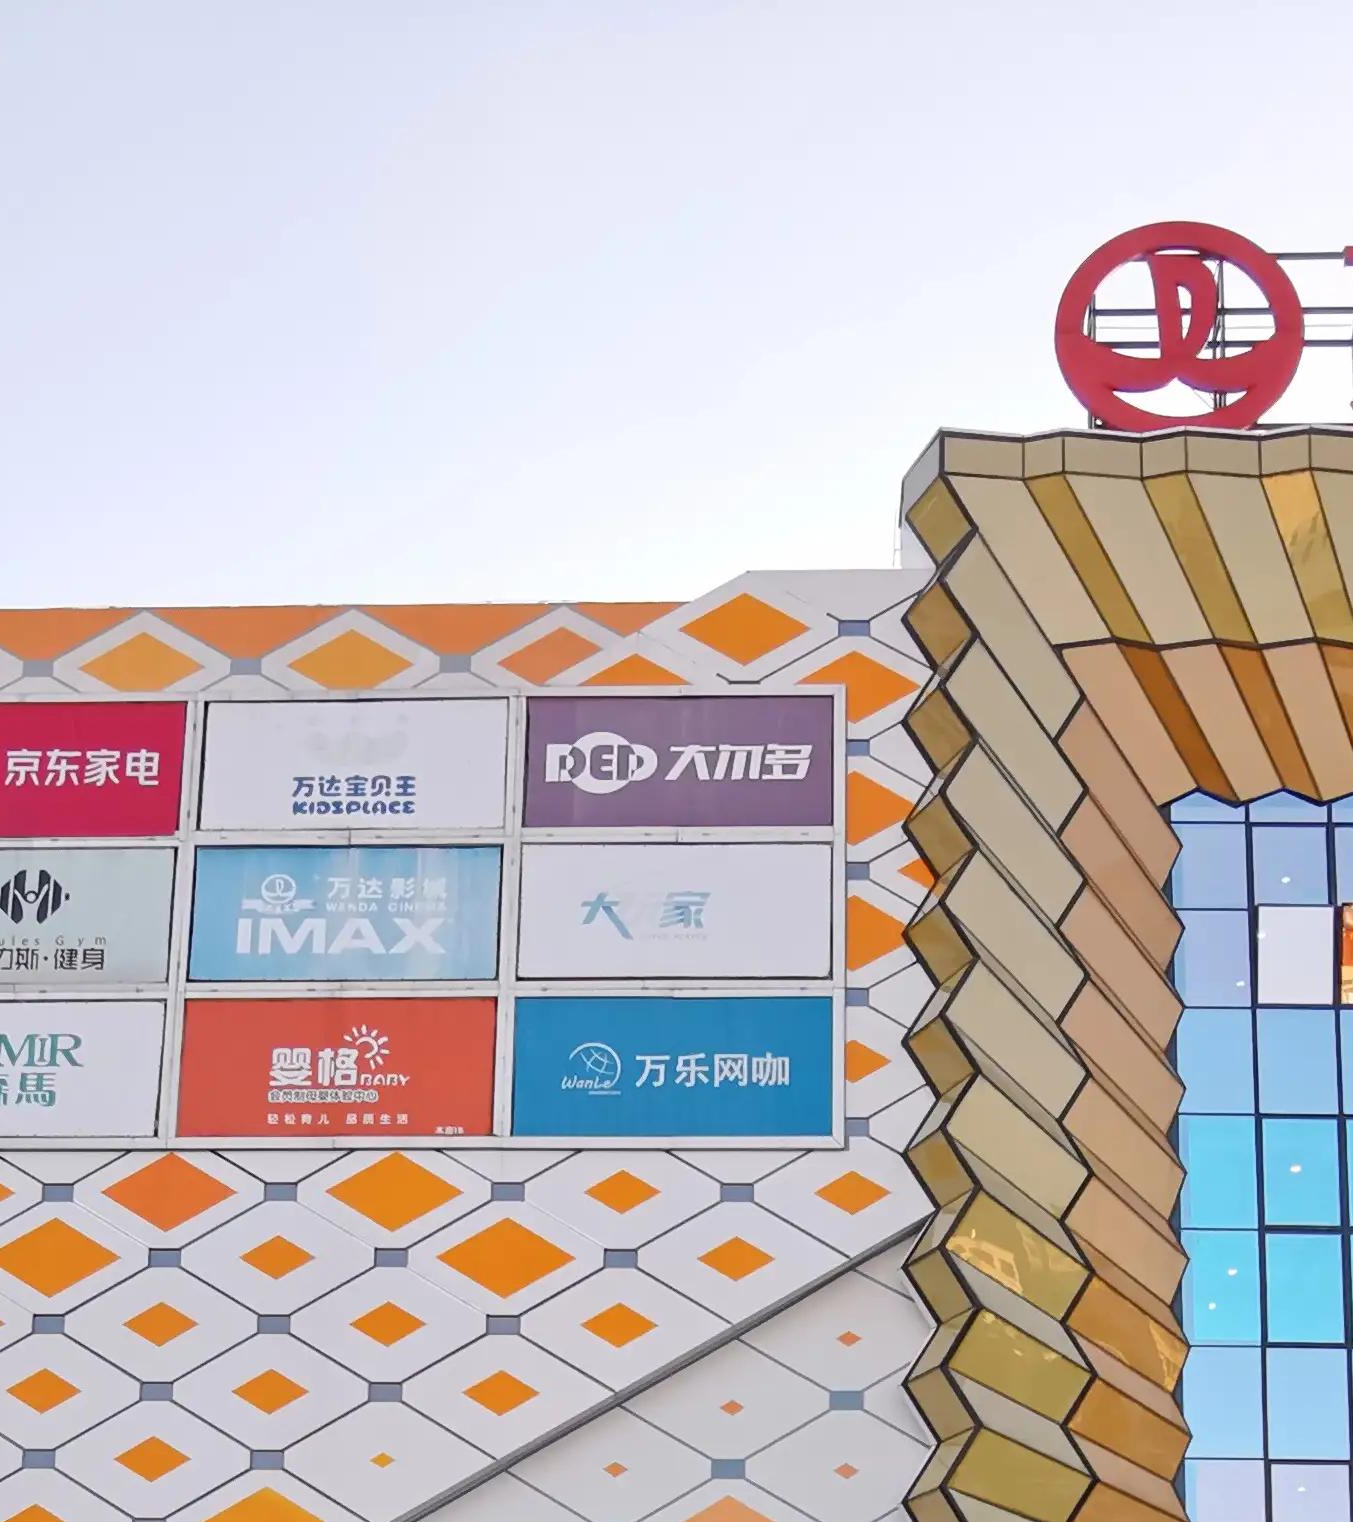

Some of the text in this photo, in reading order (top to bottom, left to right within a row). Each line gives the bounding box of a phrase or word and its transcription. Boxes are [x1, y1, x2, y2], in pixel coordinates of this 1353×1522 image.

[4, 749, 160, 786] 京东家电
[292, 775, 416, 797] 万达宝贝王
[292, 800, 416, 815] KIDSPLACE
[580, 890, 712, 940] 大家
[55, 935, 107, 946] Gym
[236, 918, 446, 955] IMAX
[360, 1074, 410, 1086] BABY
[635, 1052, 791, 1088] 万乐网咖
[267, 1113, 409, 1125] 轻松育儿 品质生活
